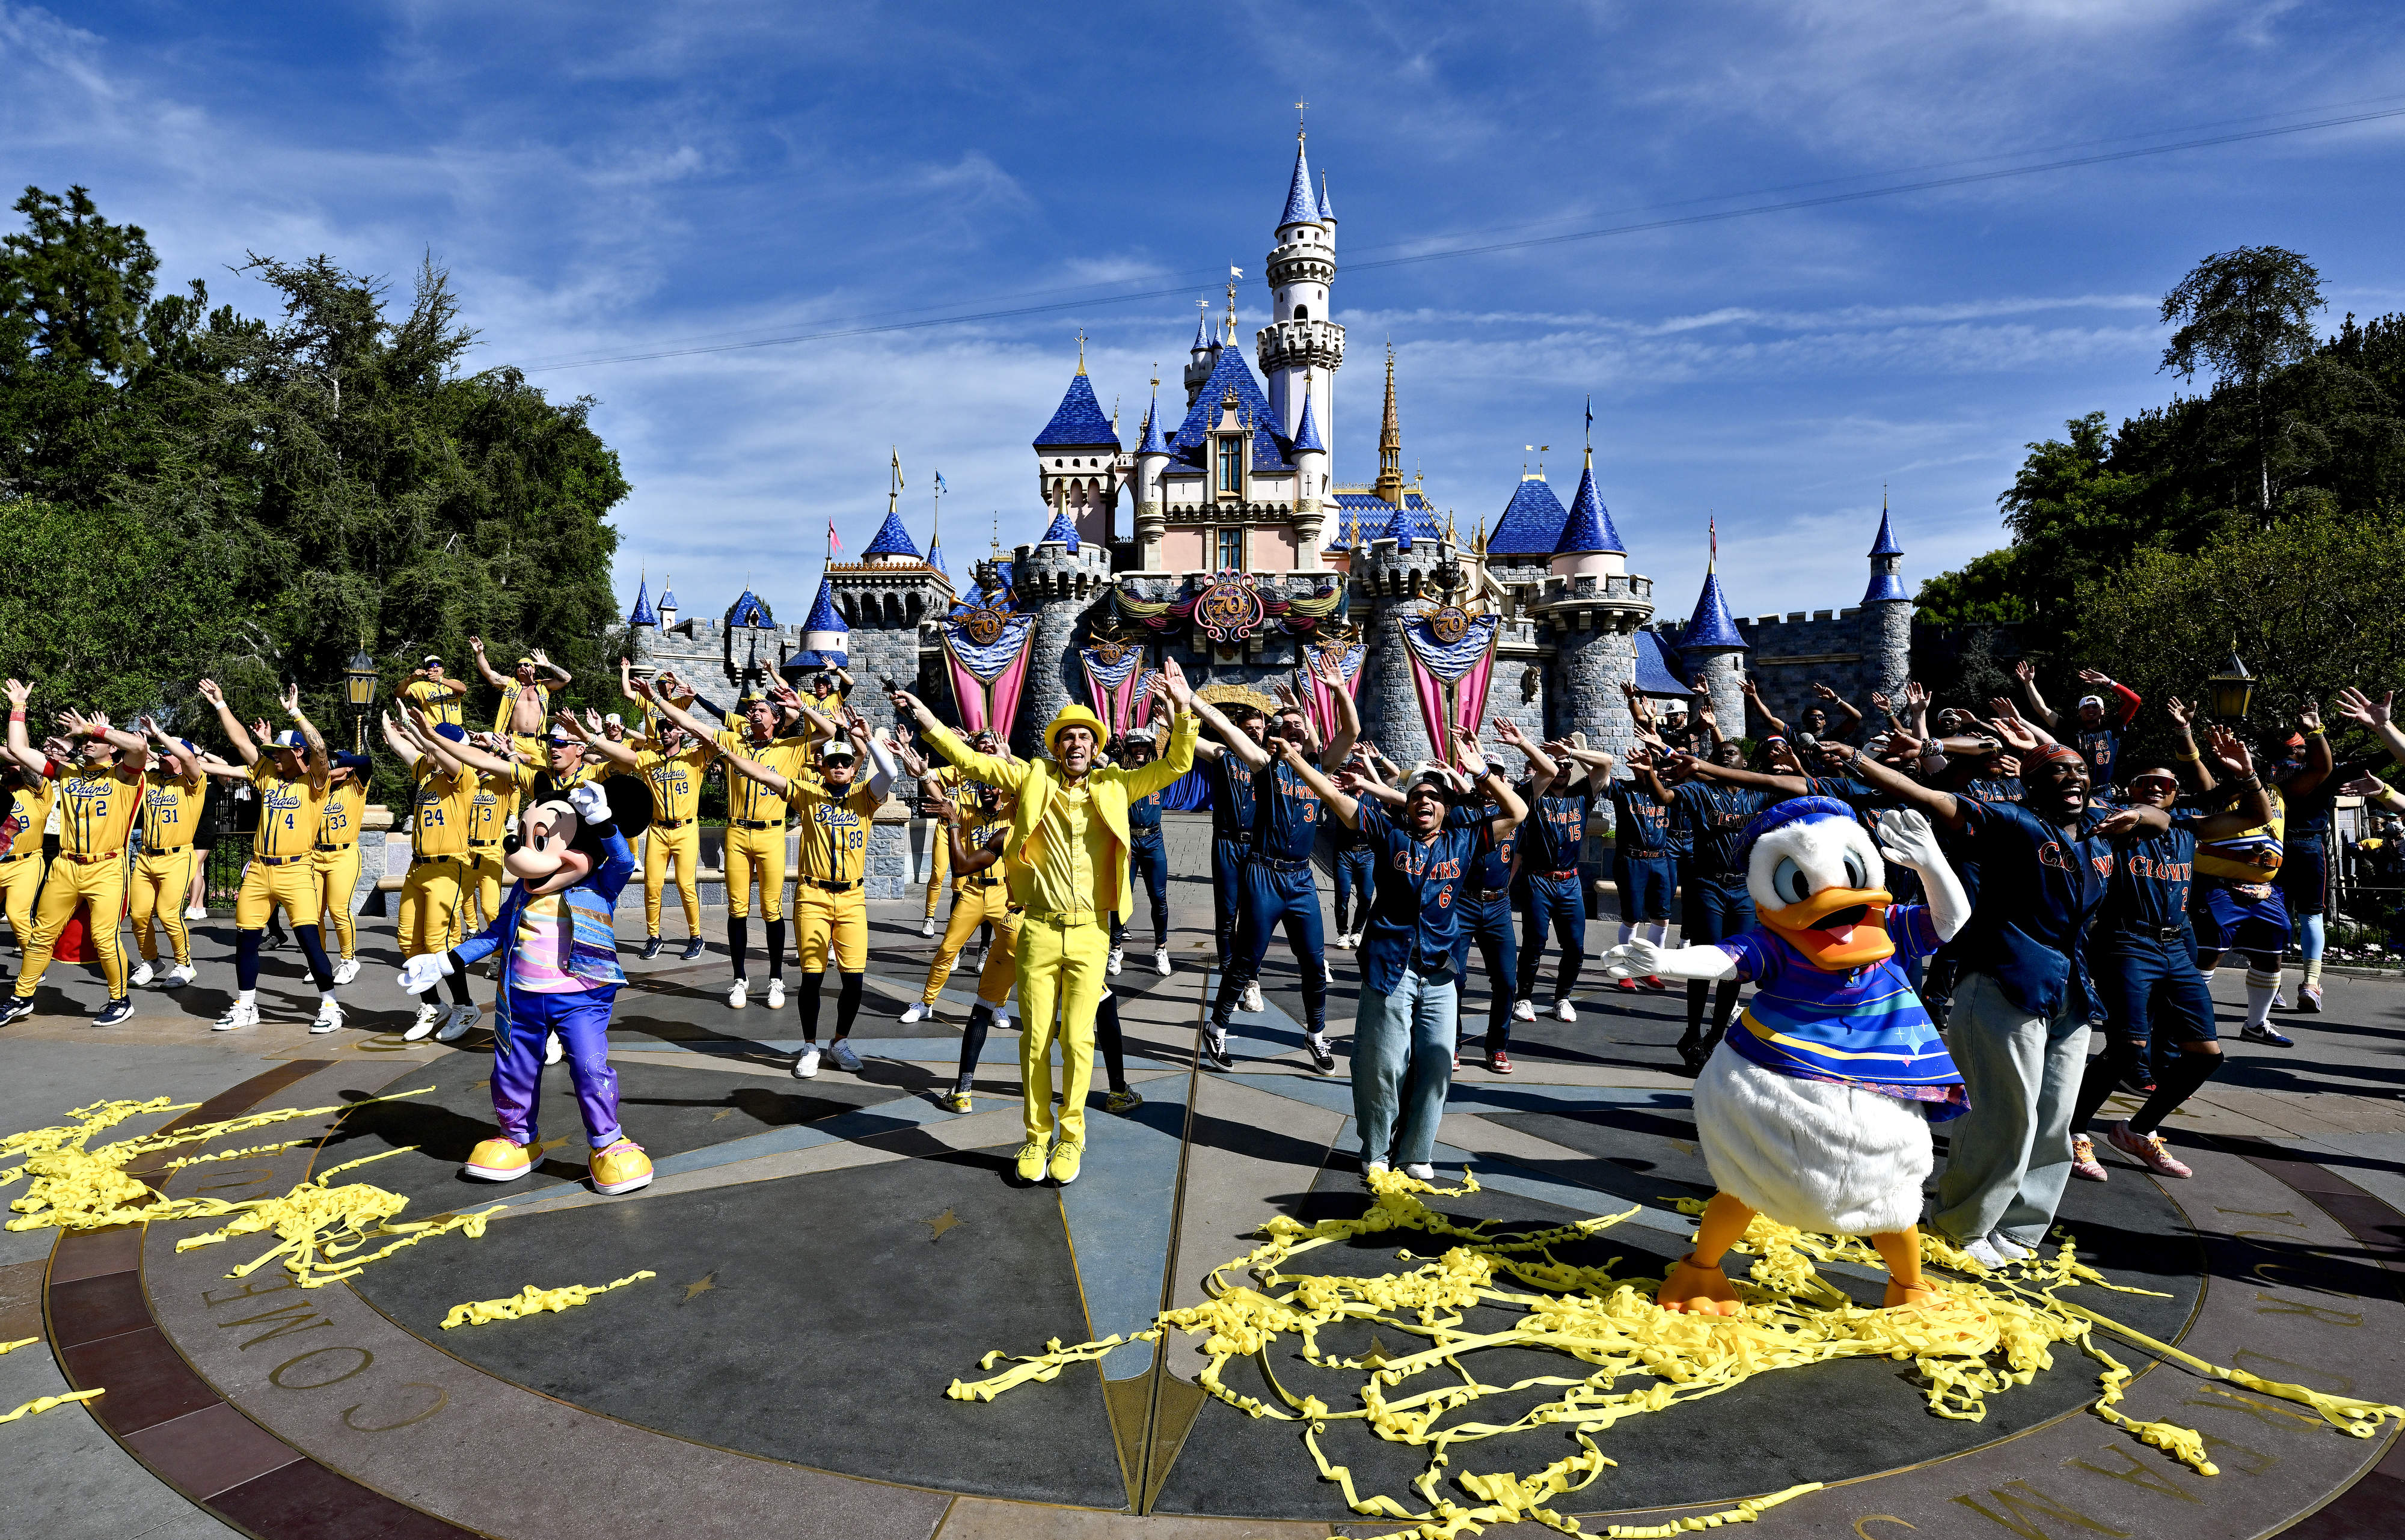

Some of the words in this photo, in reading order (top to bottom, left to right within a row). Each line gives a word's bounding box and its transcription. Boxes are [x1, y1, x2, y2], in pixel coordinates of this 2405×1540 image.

[1213, 595, 1244, 614] 70
[974, 619, 997, 635] 70
[1439, 616, 1463, 632] 70
[1104, 649, 1119, 659] 70
[1329, 646, 1344, 656] 70
[449, 701, 458, 711] 18
[2096, 751, 2111, 765] 67
[675, 782, 688, 795] 49
[1148, 790, 1160, 805] 12
[96, 800, 107, 817] 2
[162, 809, 179, 823] 31
[483, 808, 492, 822] 3
[285, 813, 295, 830] 4
[329, 814, 348, 831] 33
[423, 808, 445, 827] 24
[849, 830, 863, 849] 88
[1568, 824, 1581, 842] 15
[1501, 843, 1511, 863] 8
[2129, 855, 2192, 882] CLOWN
[1439, 884, 1453, 908] 6
[201, 1274, 450, 1433] COME
